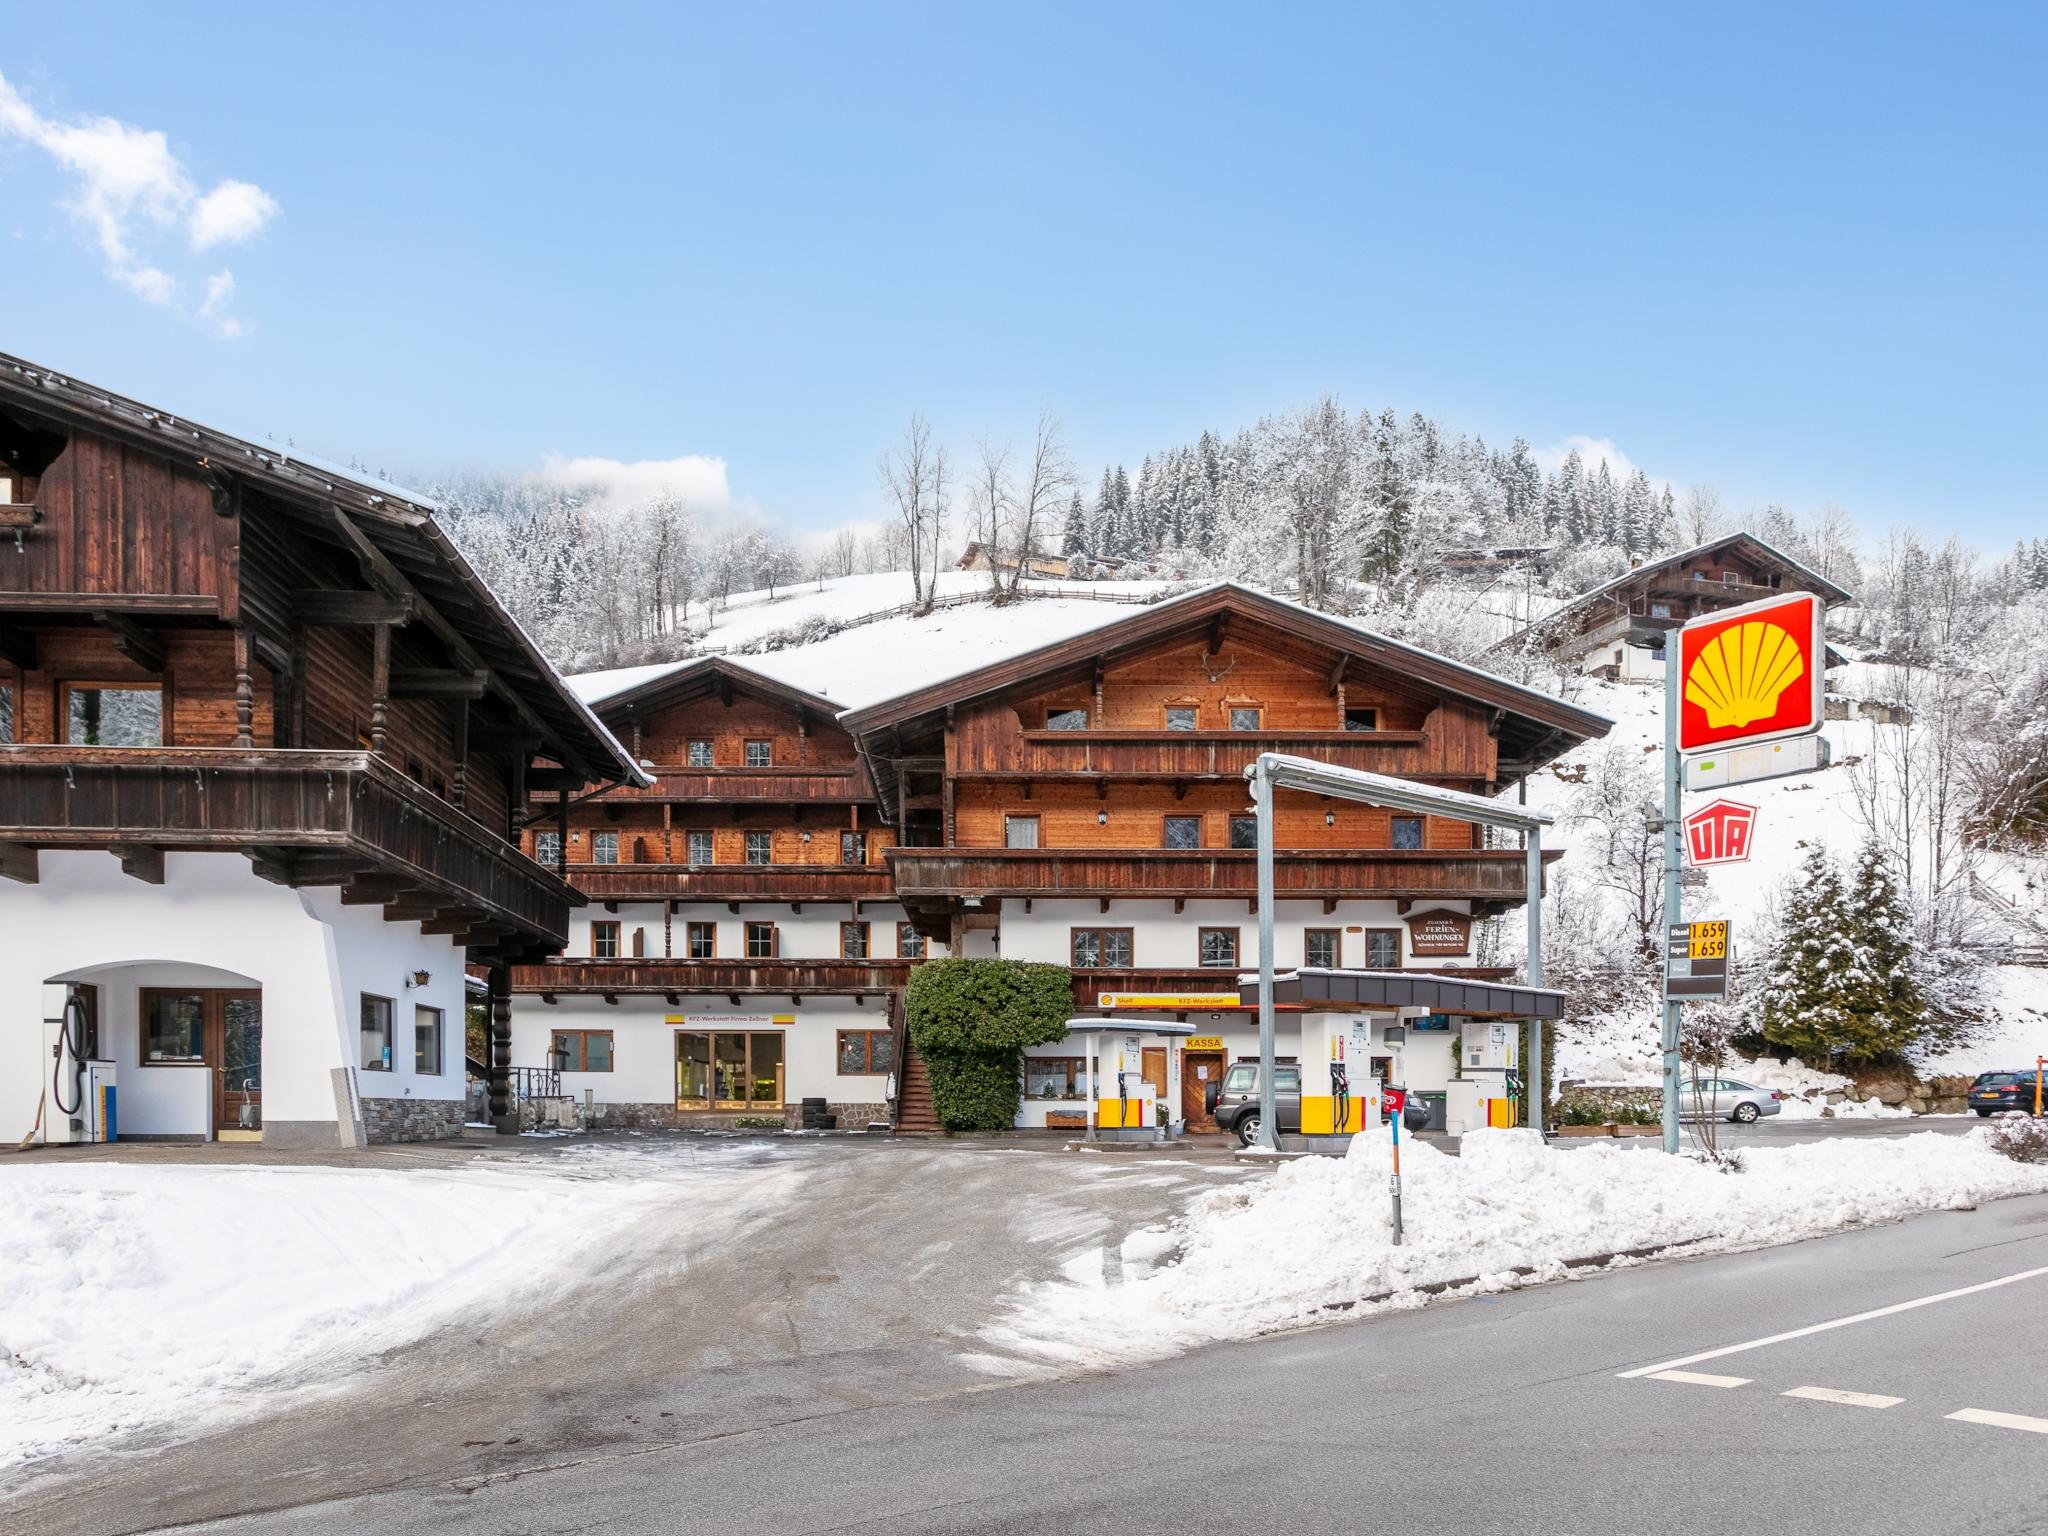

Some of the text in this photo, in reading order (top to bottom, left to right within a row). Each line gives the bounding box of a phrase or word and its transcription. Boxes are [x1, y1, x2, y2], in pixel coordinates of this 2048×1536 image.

[1688, 804, 1751, 861] UTA
[1414, 934, 1464, 942] WOHNUNGEN
[1671, 923, 1726, 939] Diesel 1.659
[1670, 941, 1725, 957] Super 1.659
[1186, 1039, 1221, 1048] KASSA
